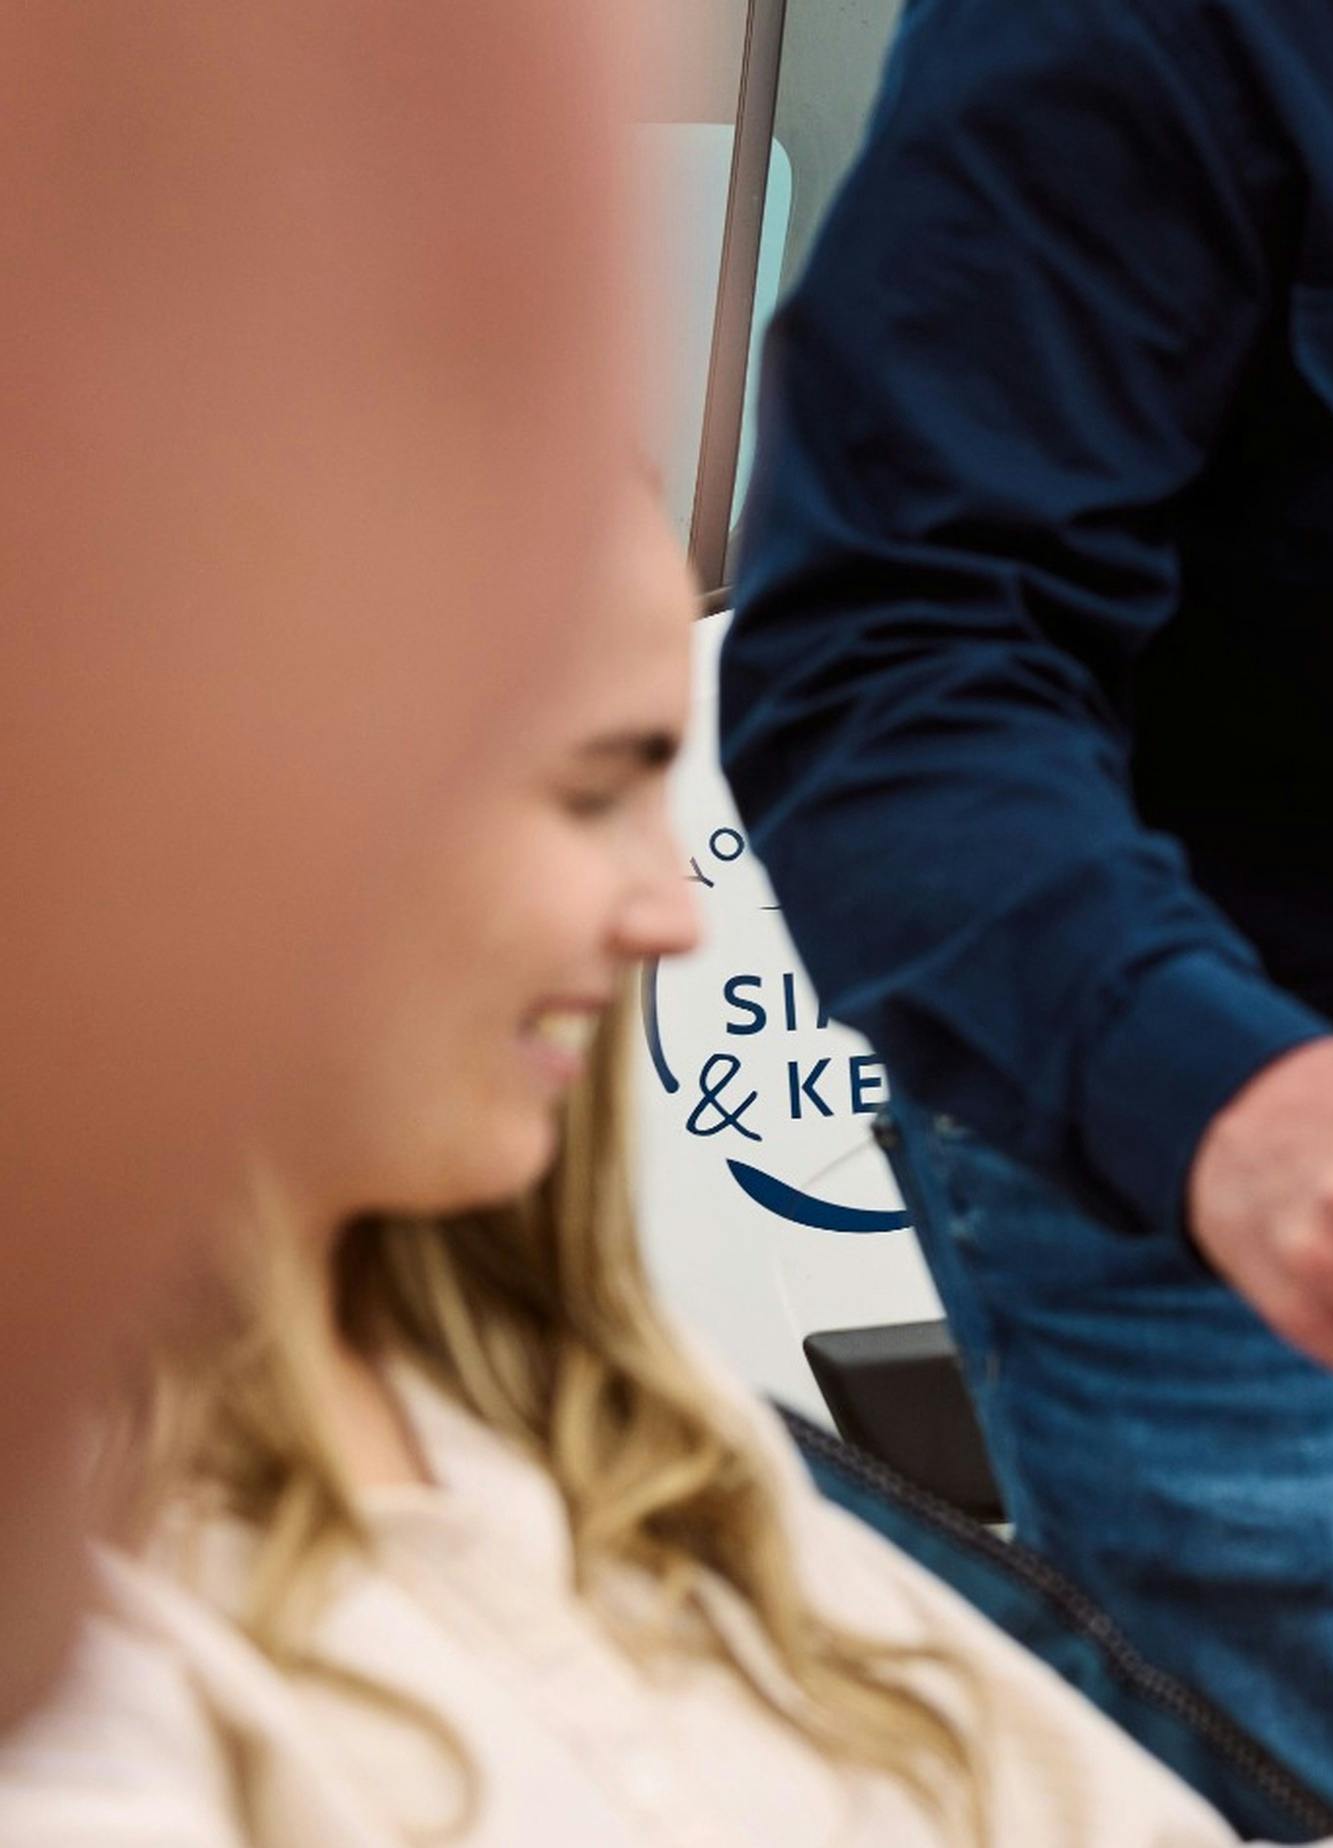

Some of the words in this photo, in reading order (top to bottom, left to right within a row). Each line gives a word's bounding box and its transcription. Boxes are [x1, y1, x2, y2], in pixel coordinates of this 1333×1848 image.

[723, 973, 831, 1036] SI
[686, 1053, 763, 1142] &
[787, 1052, 888, 1120] KE
